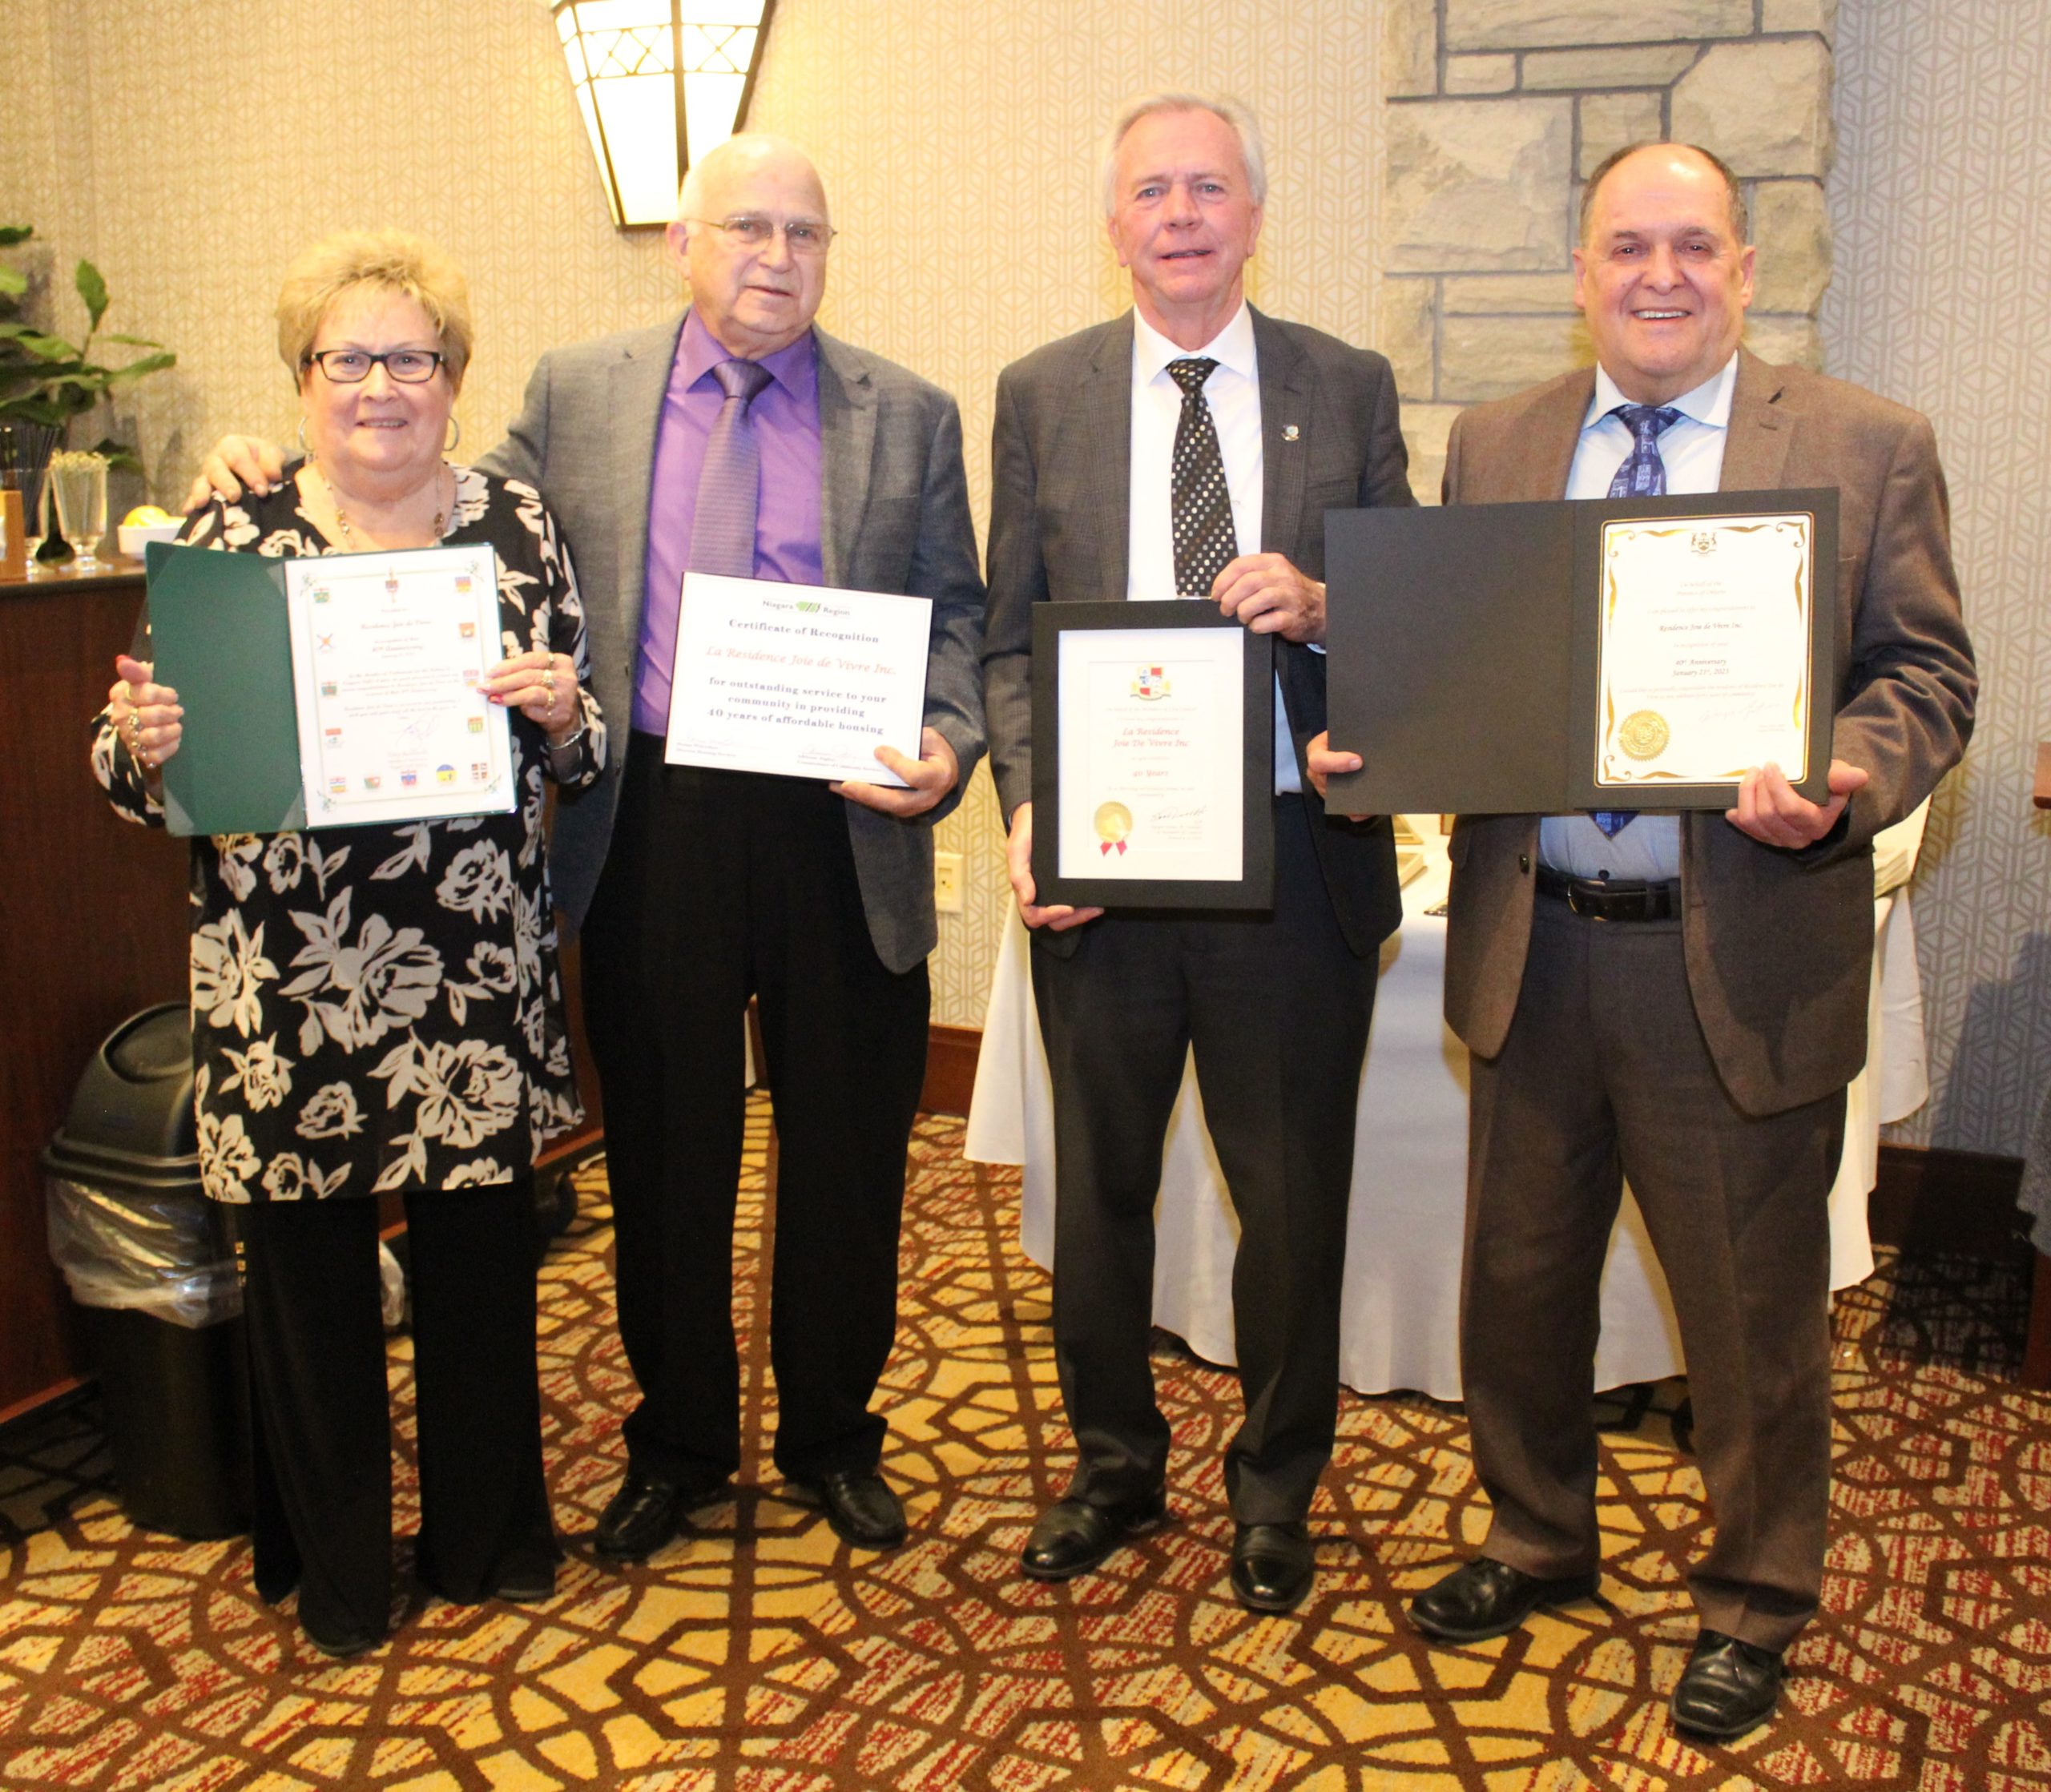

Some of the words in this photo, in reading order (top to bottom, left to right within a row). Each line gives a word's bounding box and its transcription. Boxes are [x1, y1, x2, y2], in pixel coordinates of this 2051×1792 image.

[762, 599, 794, 610] Niagara
[822, 606, 851, 617] Region
[728, 618, 792, 634] Certificate
[795, 626, 808, 635] of
[809, 628, 880, 643] Recognition
[706, 646, 723, 657] La
[725, 646, 788, 663] Residence
[788, 654, 814, 666] Joie
[816, 657, 832, 668] de
[836, 658, 871, 673] Vivre
[872, 663, 897, 676] Inc.
[708, 676, 727, 687] for
[729, 680, 800, 695] outstanding
[802, 687, 843, 699] service
[846, 691, 858, 700] to
[860, 695, 888, 704] your
[727, 695, 792, 711] community
[794, 701, 807, 711] in
[809, 704, 866, 719] providing
[707, 707, 724, 719] 40
[726, 711, 758, 721] years
[760, 714, 774, 723] of
[776, 715, 836, 730] affordable
[838, 723, 884, 735] housing
[1122, 727, 1134, 735] La
[1135, 727, 1180, 735] Residence
[1112, 739, 1129, 749] Joie
[1131, 739, 1145, 747] De
[1147, 738, 1174, 747] Vivre
[1175, 739, 1191, 747] Inc
[1146, 769, 1170, 779] Years
